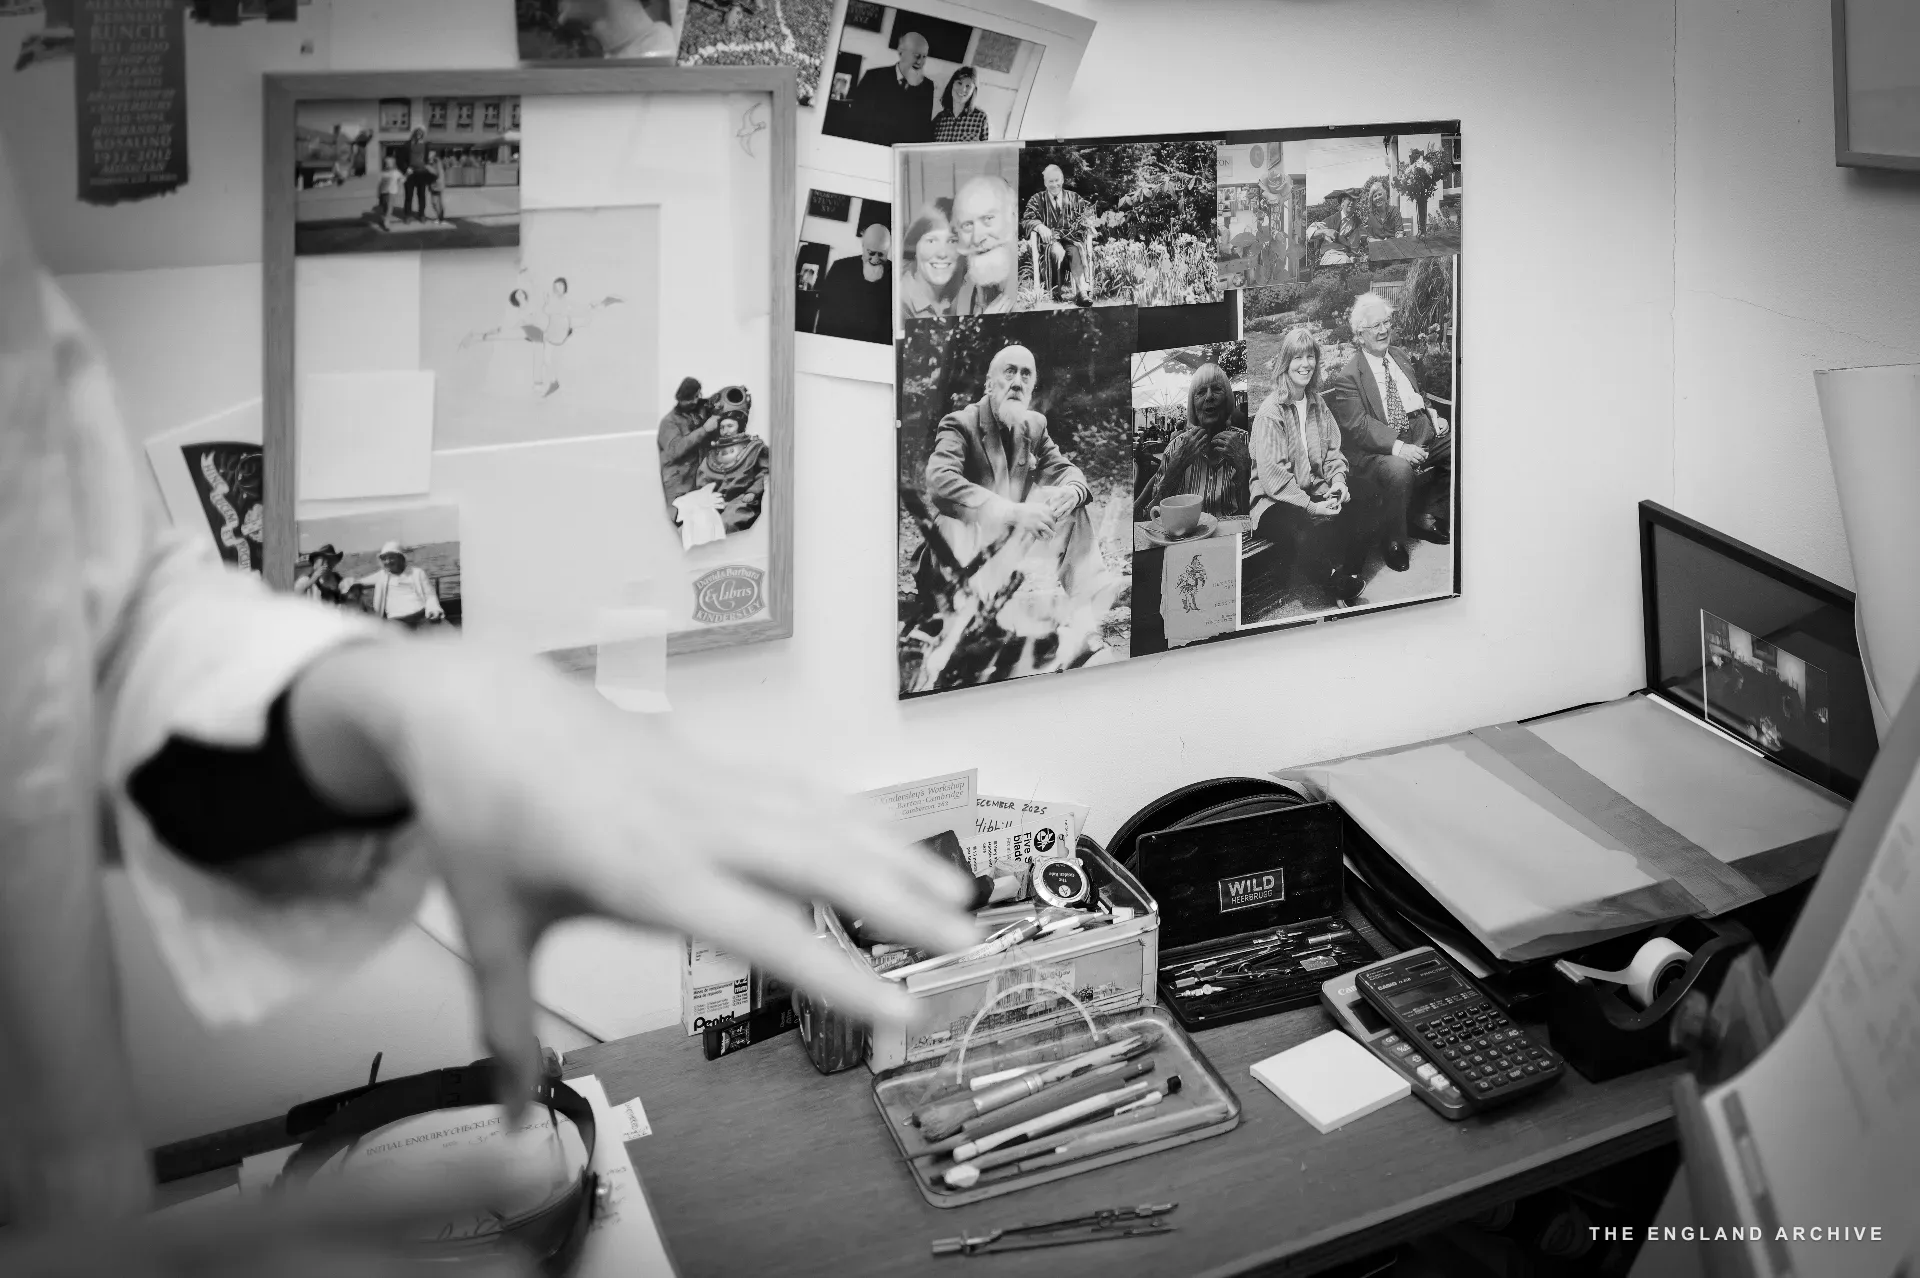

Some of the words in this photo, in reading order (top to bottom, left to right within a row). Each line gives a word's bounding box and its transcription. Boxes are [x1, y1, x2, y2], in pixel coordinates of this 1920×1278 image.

[94, 136, 172, 150] ROSALIND
[696, 570, 720, 590] David
[726, 567, 760, 580] Barbara
[696, 600, 761, 623] KINDERSLEY
[927, 782, 966, 796] Workshop
[1021, 803, 1048, 815] 2025
[1023, 831, 1033, 854] Five
[1227, 875, 1275, 897] WILD
[1231, 889, 1273, 905] HEERBRUGG
[1377, 981, 1398, 991] CASIO
[366, 1139, 404, 1157] INITIAL
[405, 1127, 450, 1147] ENQUIRY
[451, 1117, 502, 1136] CHECKLIST
